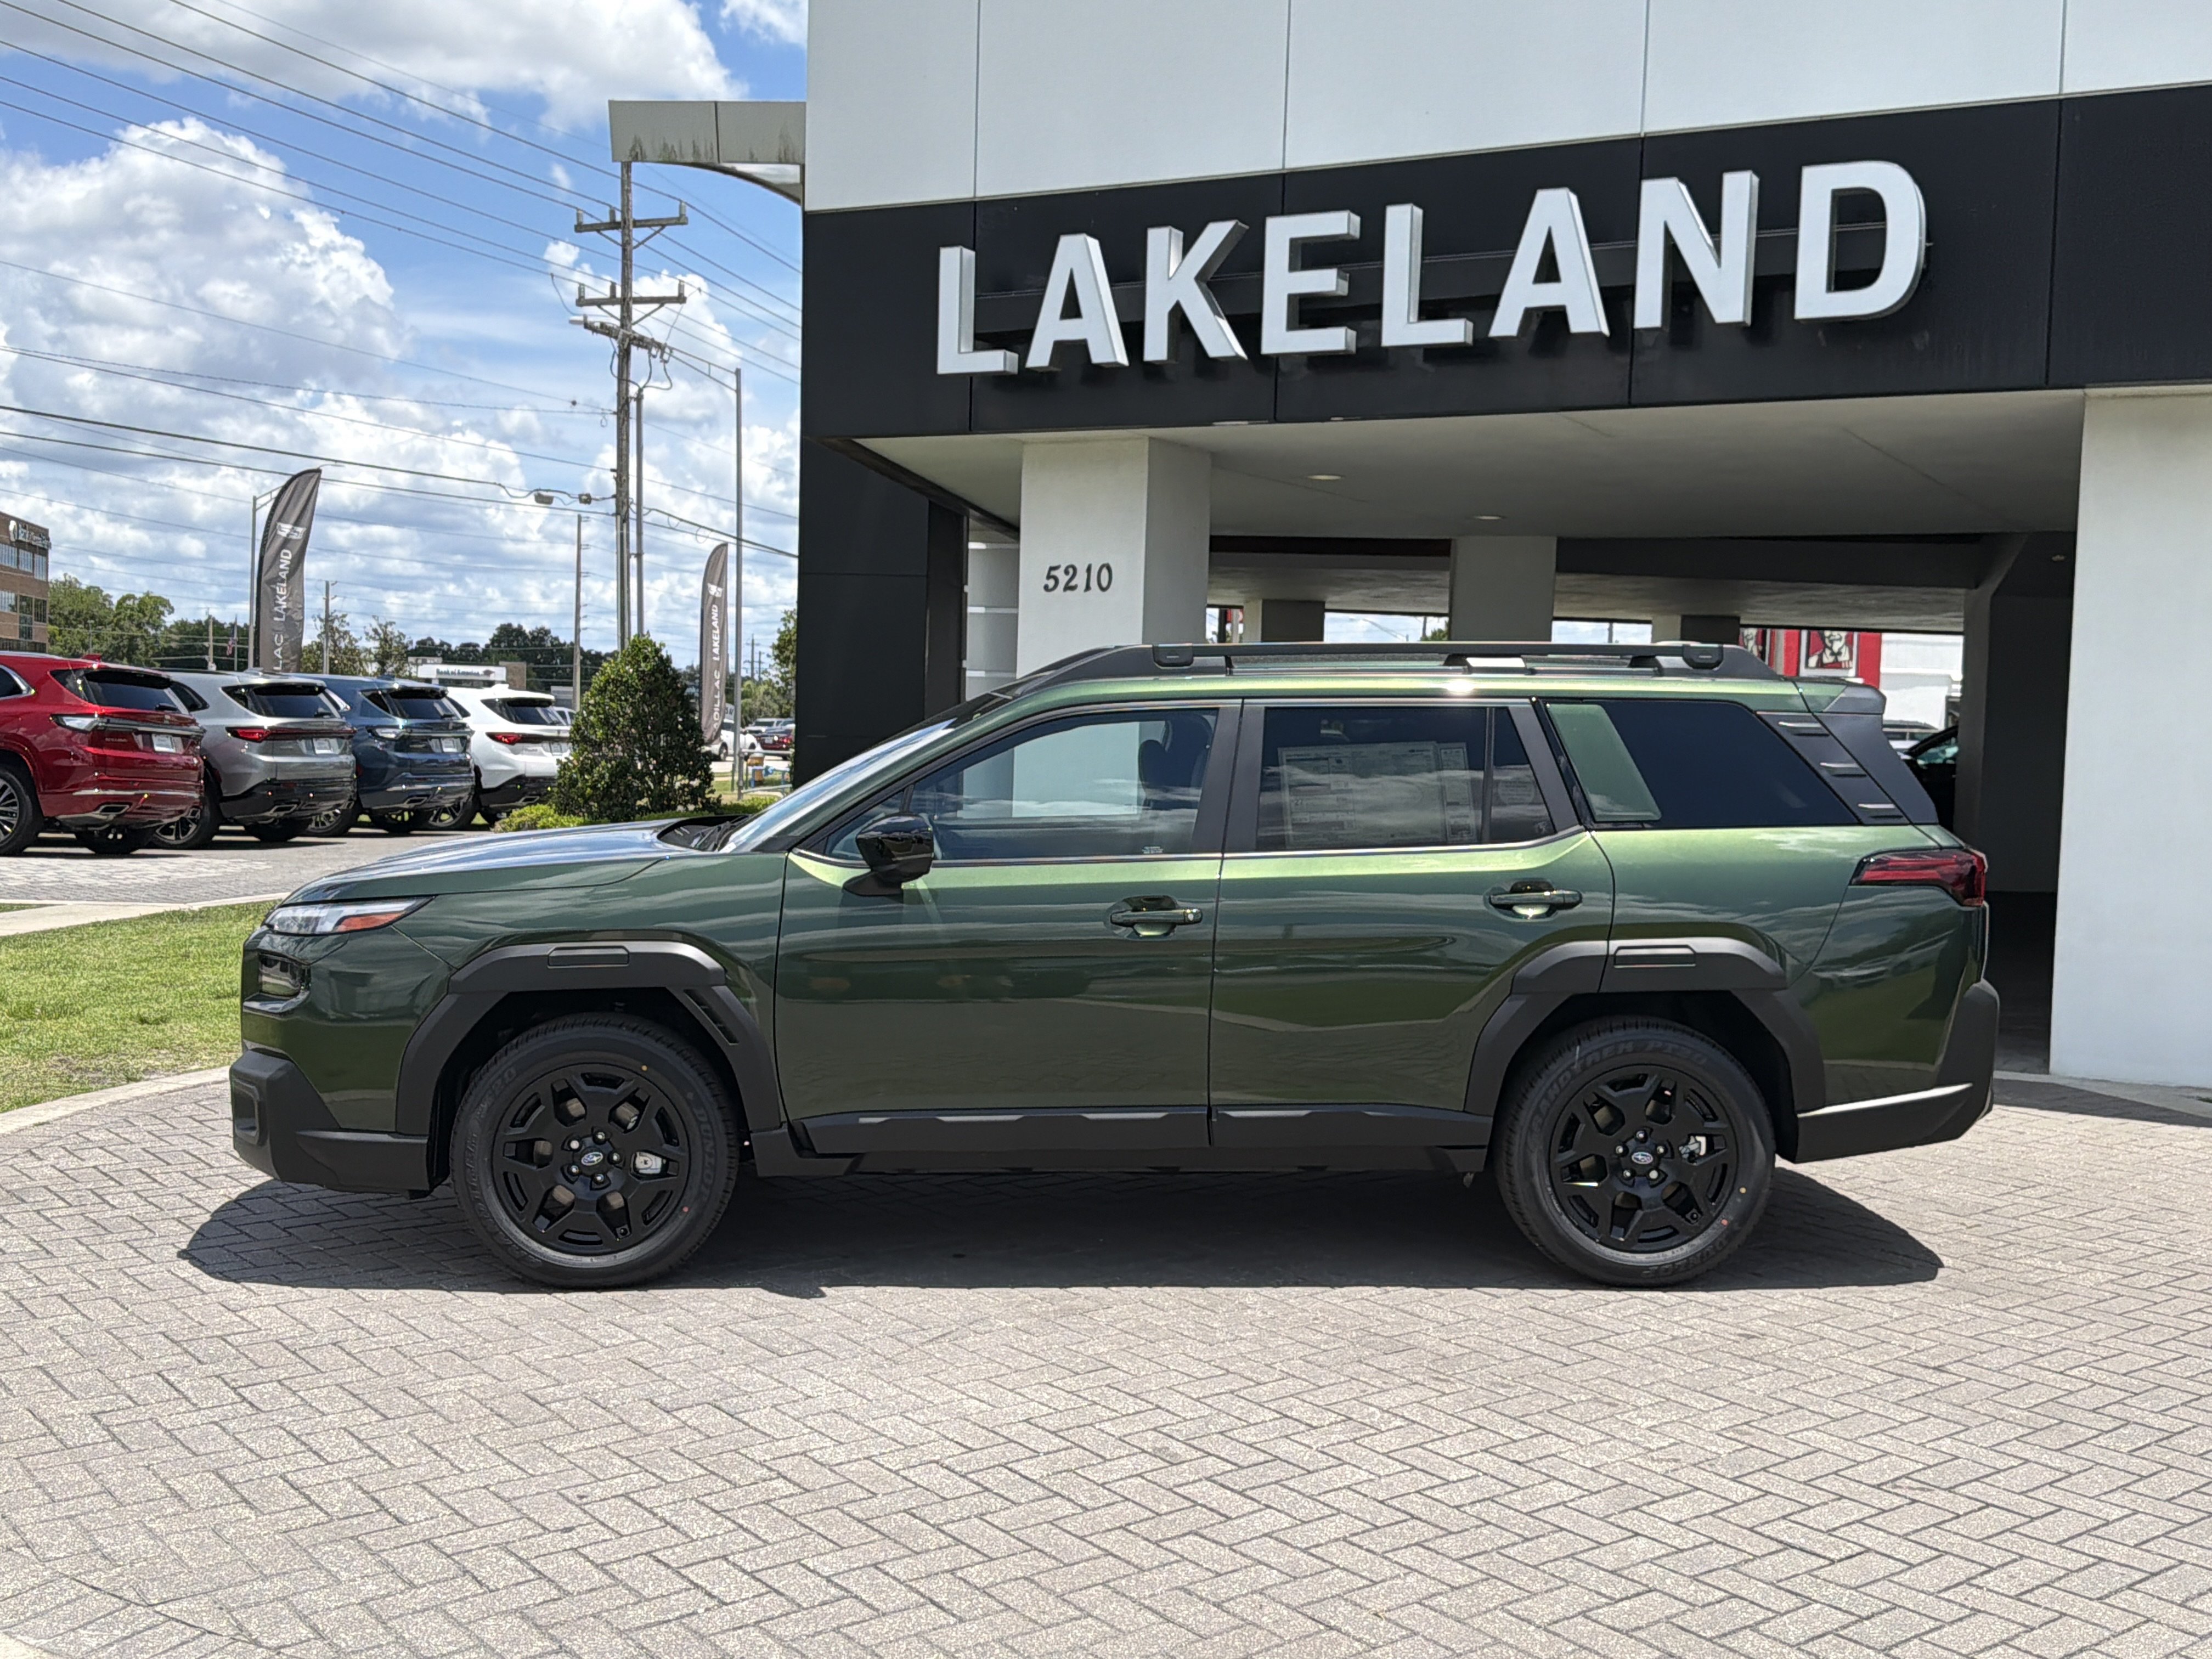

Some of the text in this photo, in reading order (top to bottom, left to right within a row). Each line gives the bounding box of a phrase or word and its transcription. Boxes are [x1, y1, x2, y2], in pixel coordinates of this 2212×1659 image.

[936, 160, 1926, 376] LAKELAND
[273, 549, 292, 622] LAKELAND
[1043, 562, 1113, 593] 5210
[712, 605, 720, 661] LAKELAND
[693, 1106, 715, 1202] DUNLOP
